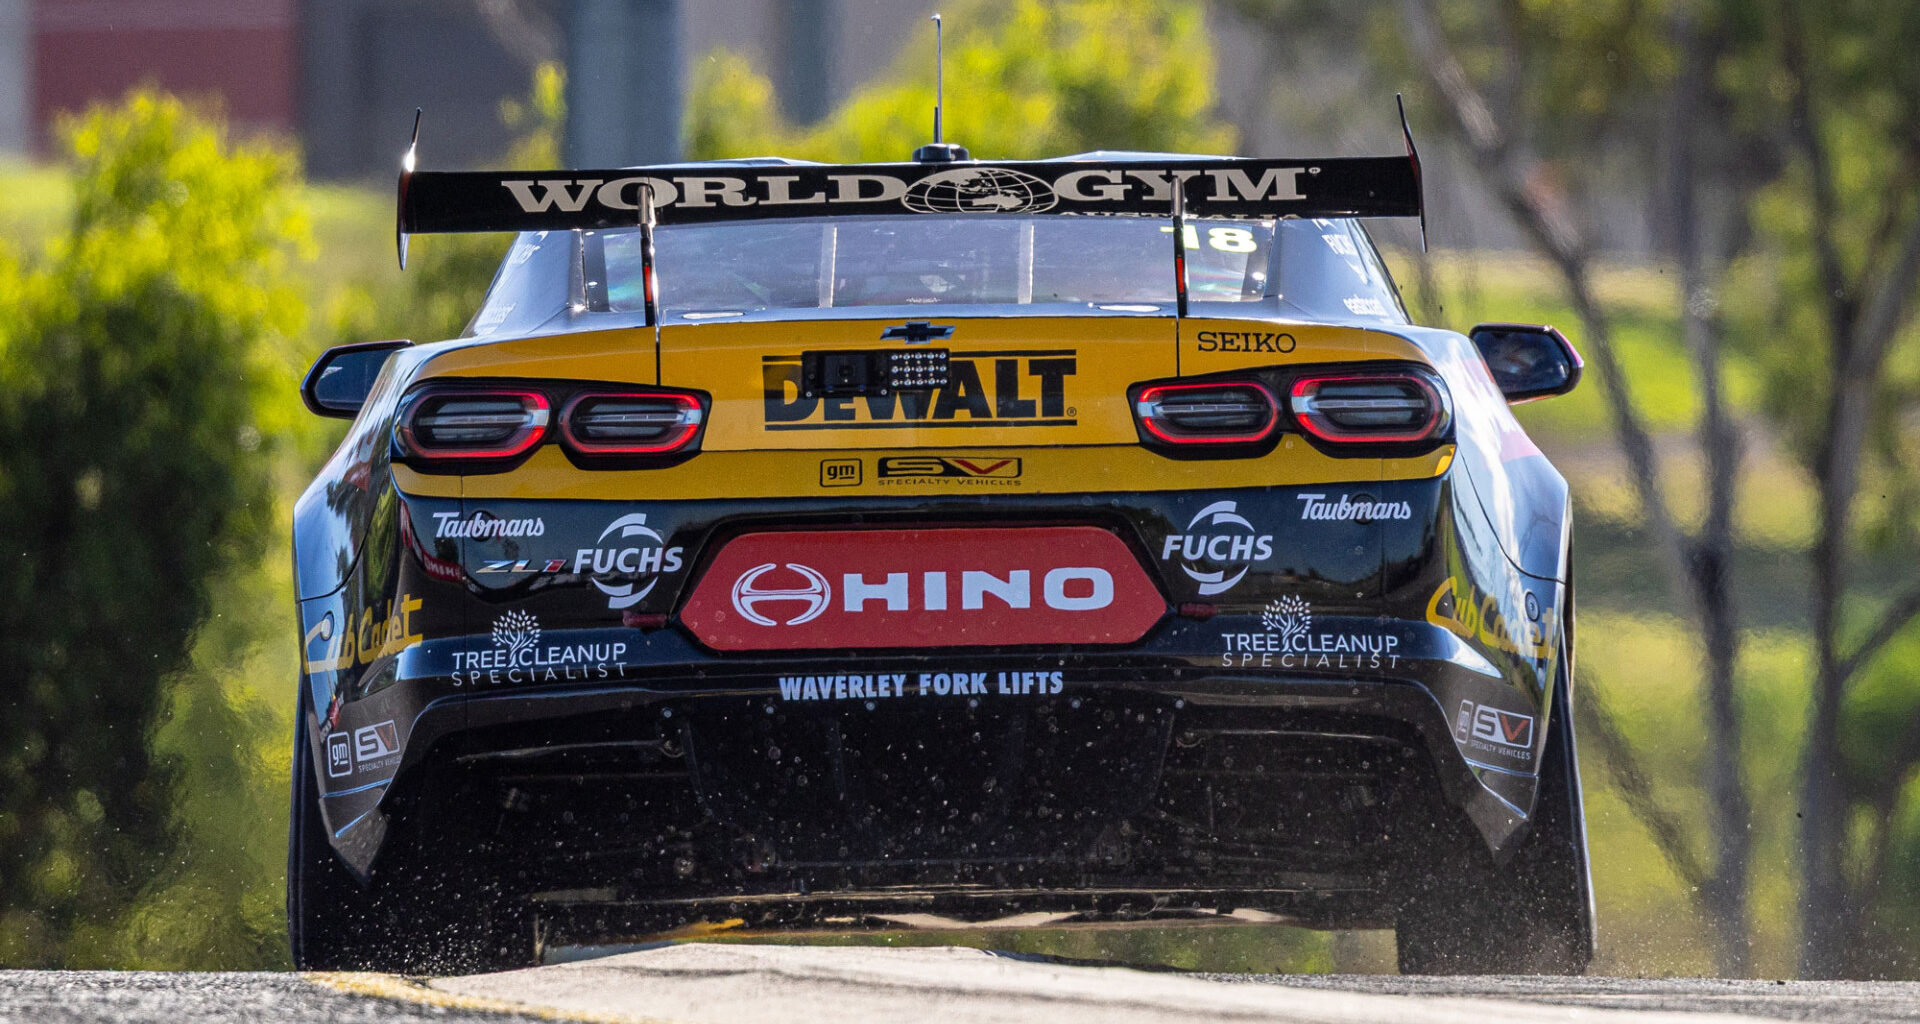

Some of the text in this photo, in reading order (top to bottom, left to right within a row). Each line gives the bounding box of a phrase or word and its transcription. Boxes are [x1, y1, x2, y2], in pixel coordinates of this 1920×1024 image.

[501, 168, 1307, 213] WORLD GYM
[1160, 224, 1257, 253] 18
[1198, 332, 1296, 354] SEIKO
[886, 457, 1014, 477] SV
[878, 477, 1022, 486] SPECIALTY VEHICLES
[1297, 493, 1411, 521] Taubmans
[433, 511, 545, 538] Taubmans
[573, 546, 684, 574] FUCHS
[1162, 534, 1273, 561] FUCHS
[843, 567, 1114, 612] HINO
[1426, 575, 1478, 639] Cub
[303, 593, 423, 674] Cub Cadet
[1221, 633, 1399, 653] TREE CLEANUP
[452, 642, 627, 670] TREE CLEANUP
[1221, 652, 1401, 669] SPECIALIST
[451, 661, 627, 687] SPECIALIST
[779, 671, 1064, 701] WAVERLEY FORK LIFTS
[359, 723, 393, 756] SV
[1476, 710, 1529, 742] SV
